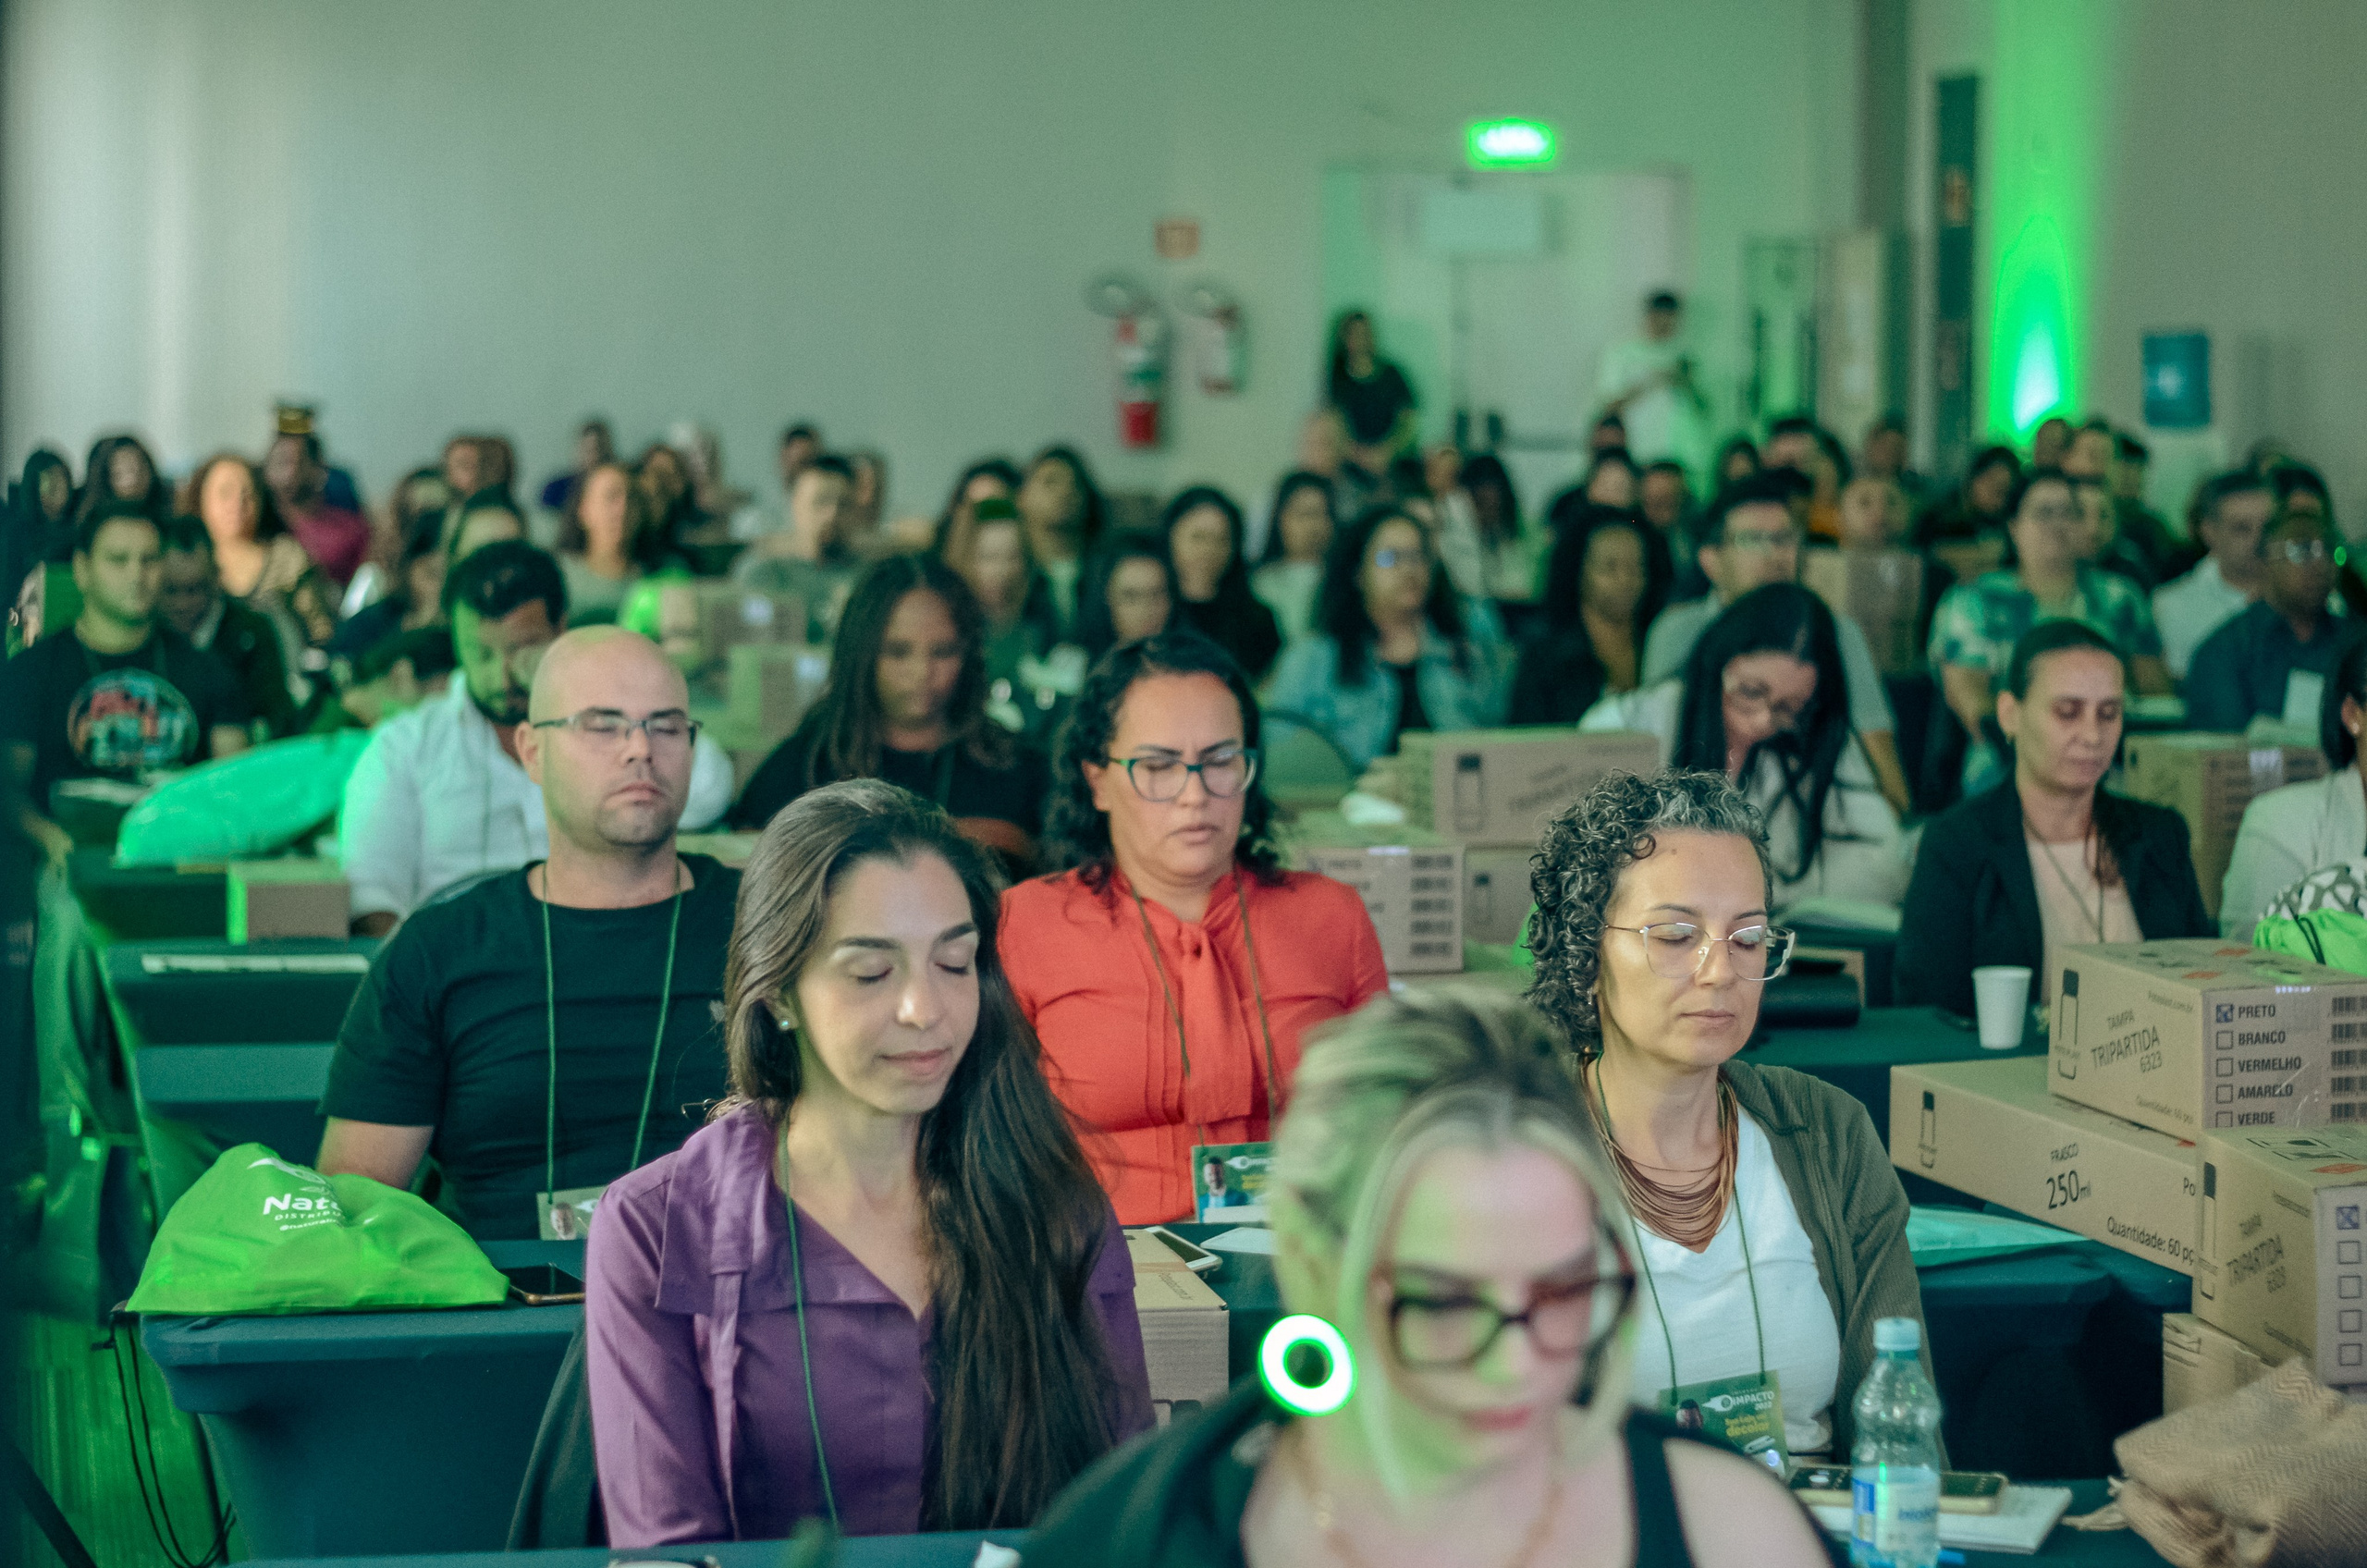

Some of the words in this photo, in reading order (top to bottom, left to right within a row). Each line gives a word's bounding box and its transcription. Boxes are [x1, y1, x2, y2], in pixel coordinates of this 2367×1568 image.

[2107, 1008, 2135, 1030] TAMPA
[2238, 1004, 2275, 1018] PRETO
[2238, 1030, 2286, 1046] BRANCO
[2091, 1024, 2161, 1071] TRIPARTIDA
[2238, 1056, 2301, 1072] VERMELHO
[2238, 1084, 2293, 1099] AMARELO
[2238, 1111, 2275, 1125] VERDE
[2050, 1143, 2079, 1161] FRASCO
[2107, 1216, 2166, 1253] Quantidade:
[2168, 1238, 2180, 1257] 60
